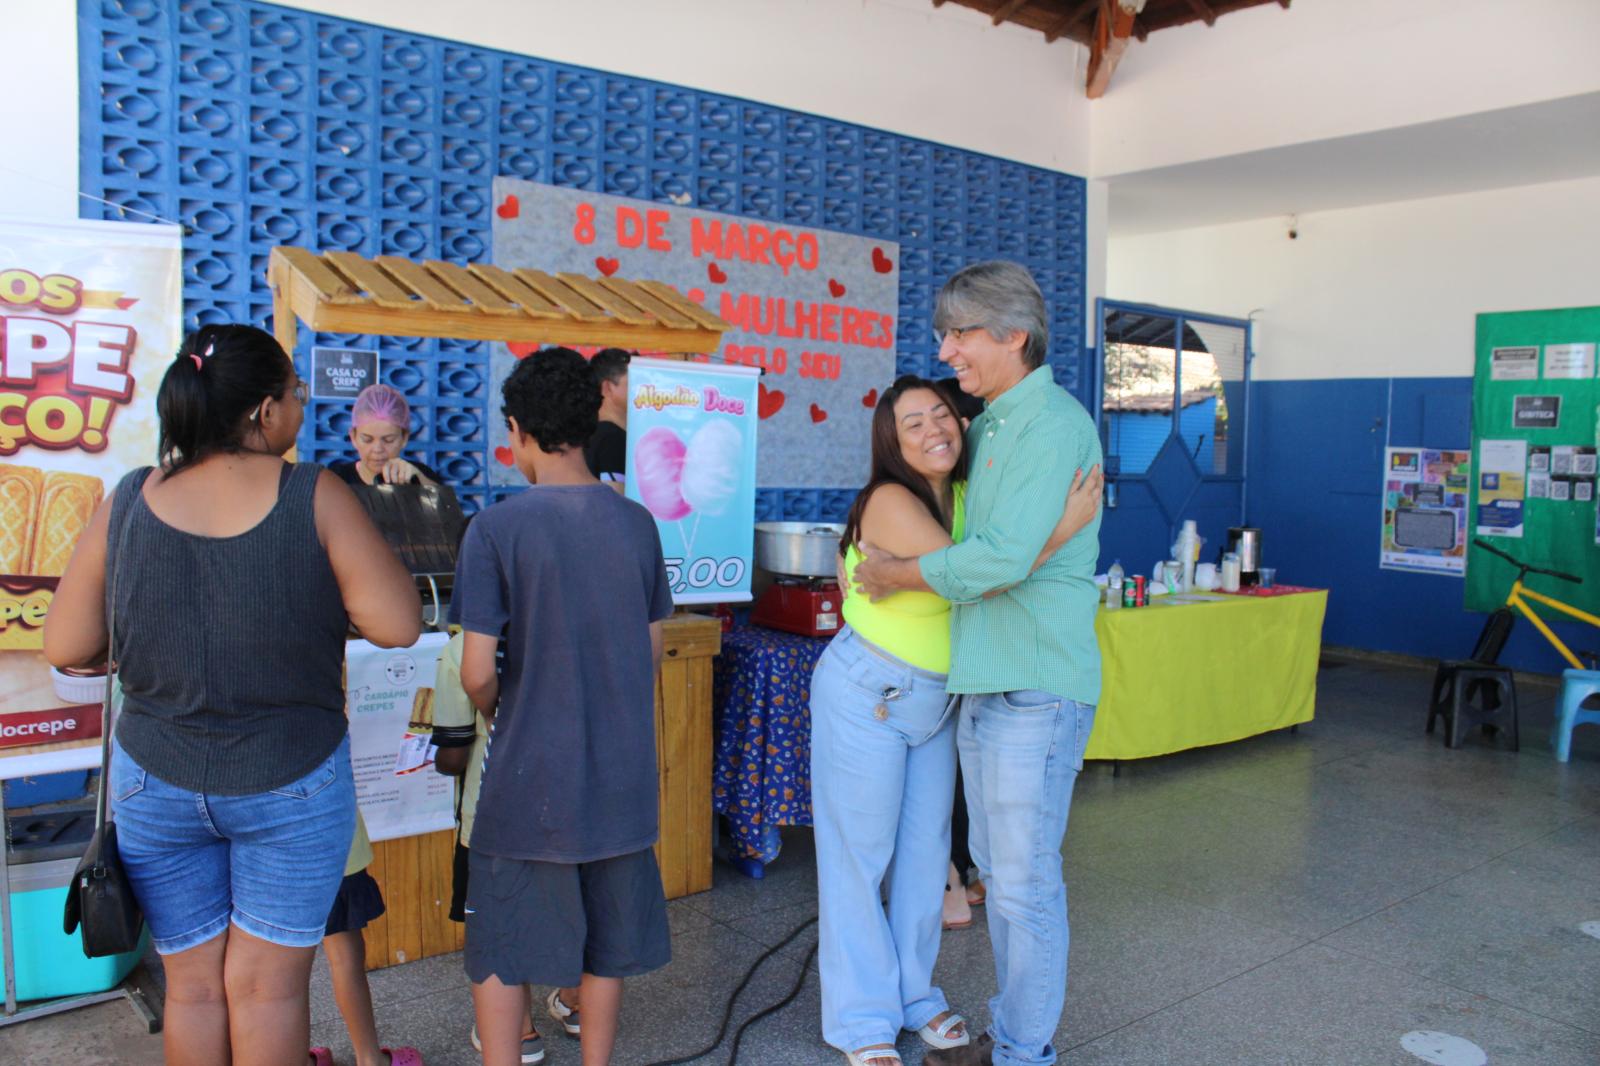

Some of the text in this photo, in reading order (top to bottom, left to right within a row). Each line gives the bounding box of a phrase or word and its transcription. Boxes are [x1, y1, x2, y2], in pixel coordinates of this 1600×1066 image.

[574, 203, 819, 276] 8 DE MARÇO
[720, 291, 893, 350] MULHERES
[0, 316, 134, 400] PE
[326, 367, 367, 378] CASA DO
[724, 343, 787, 375] PELO
[798, 351, 841, 381] SEU
[332, 377, 360, 386] CREPE
[633, 384, 745, 416] Algodão Doce
[356, 702, 396, 713] CREPES
[0, 718, 77, 738] ocrepe
